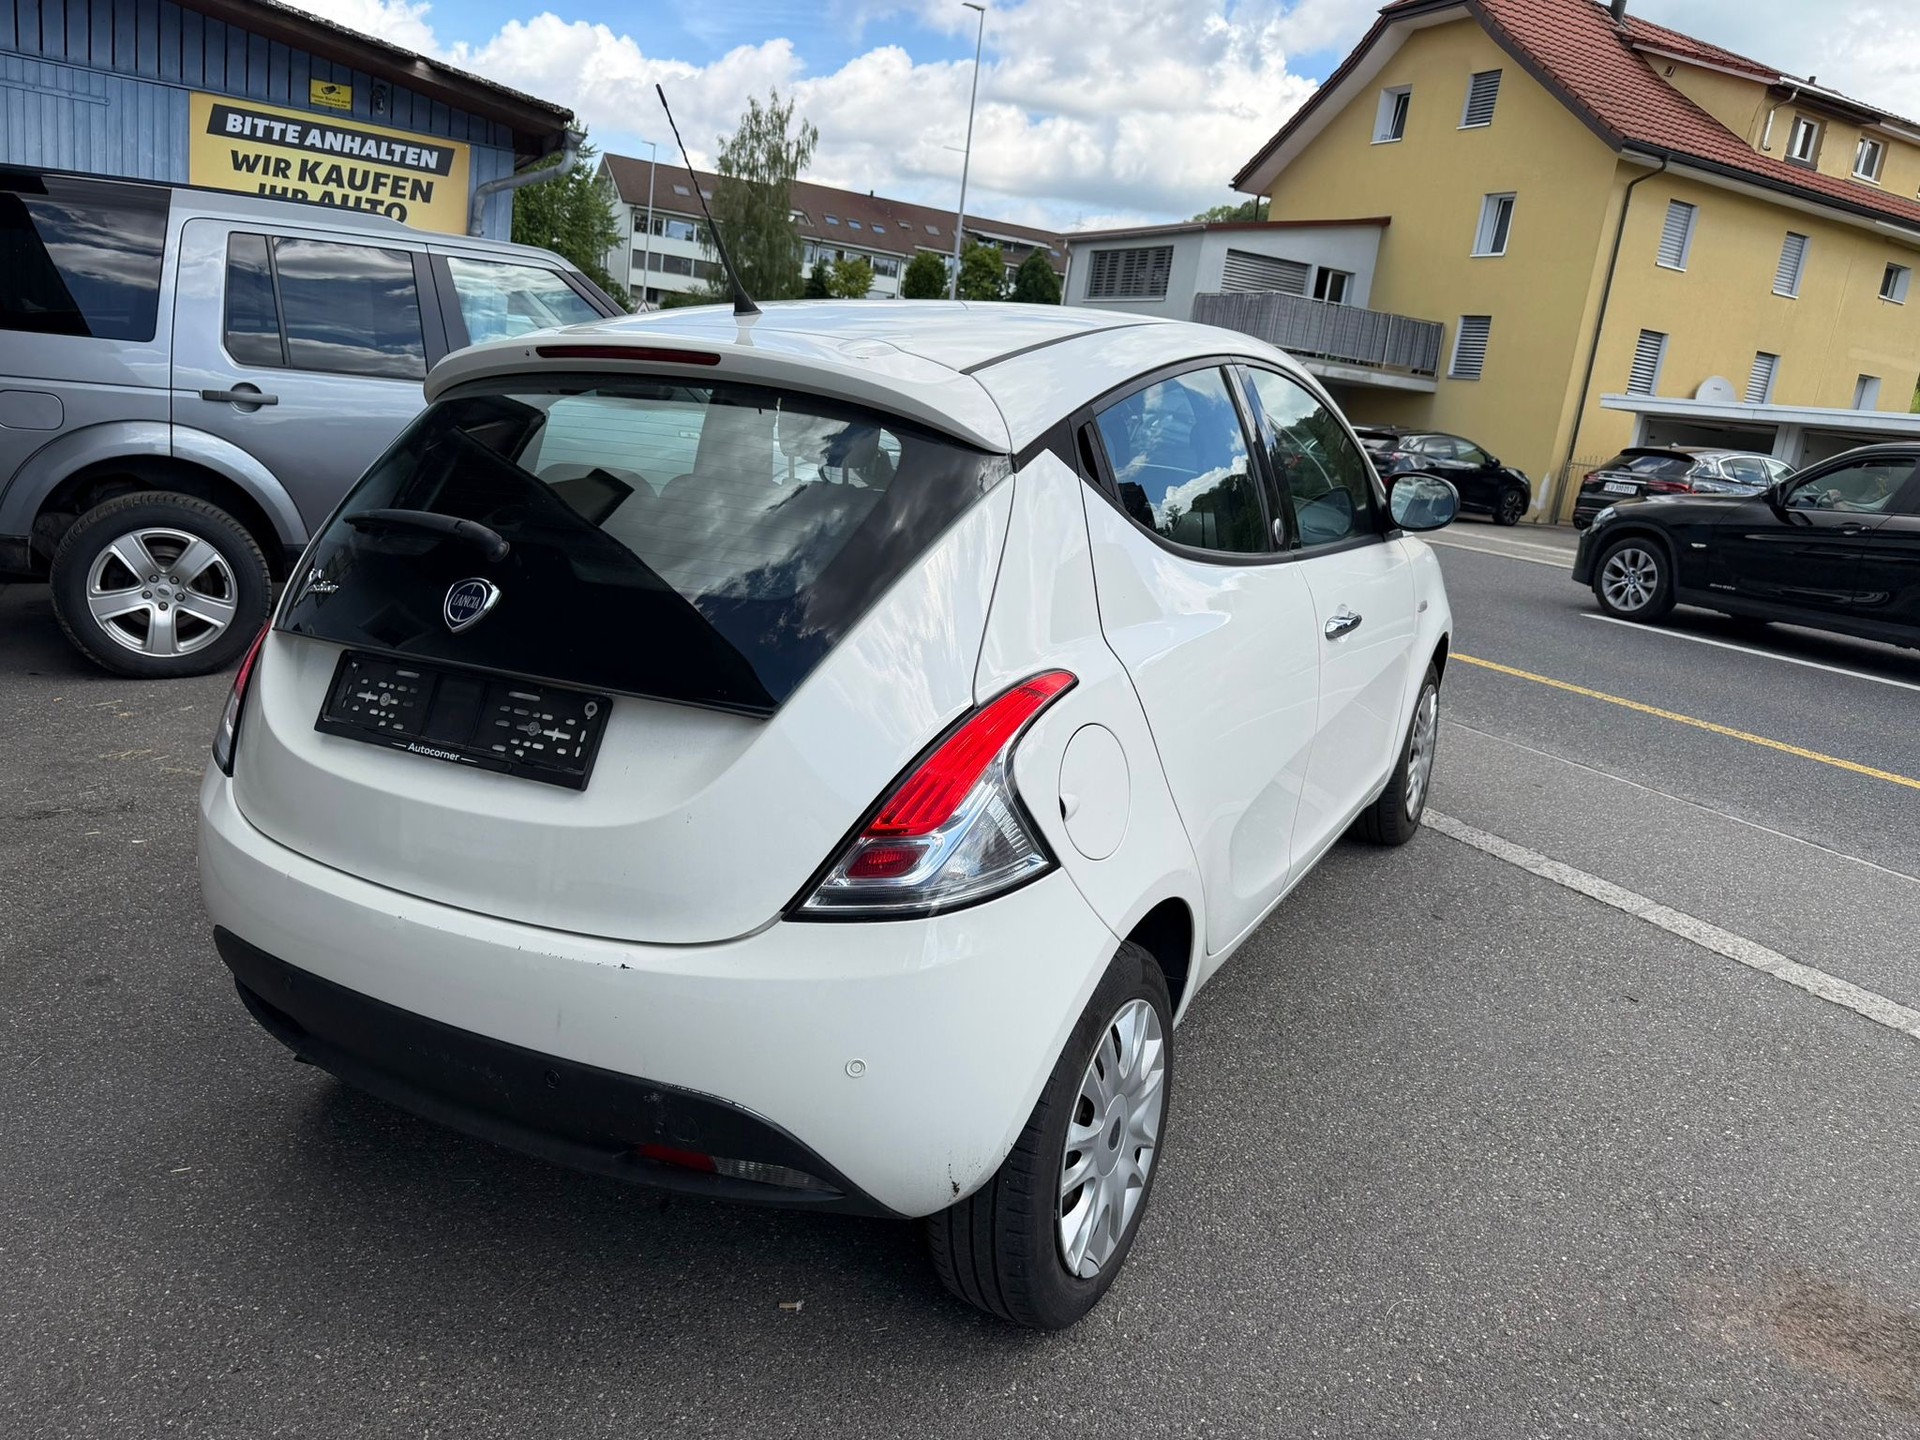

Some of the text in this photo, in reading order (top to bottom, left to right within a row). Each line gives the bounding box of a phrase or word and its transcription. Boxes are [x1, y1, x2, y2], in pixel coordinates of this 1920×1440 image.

[225, 113, 439, 170] BITTE ANHALTEN
[231, 149, 434, 203] WIR KAUFEN
[453, 593, 480, 610] LANCIA
[407, 742, 460, 761] Autocorner
